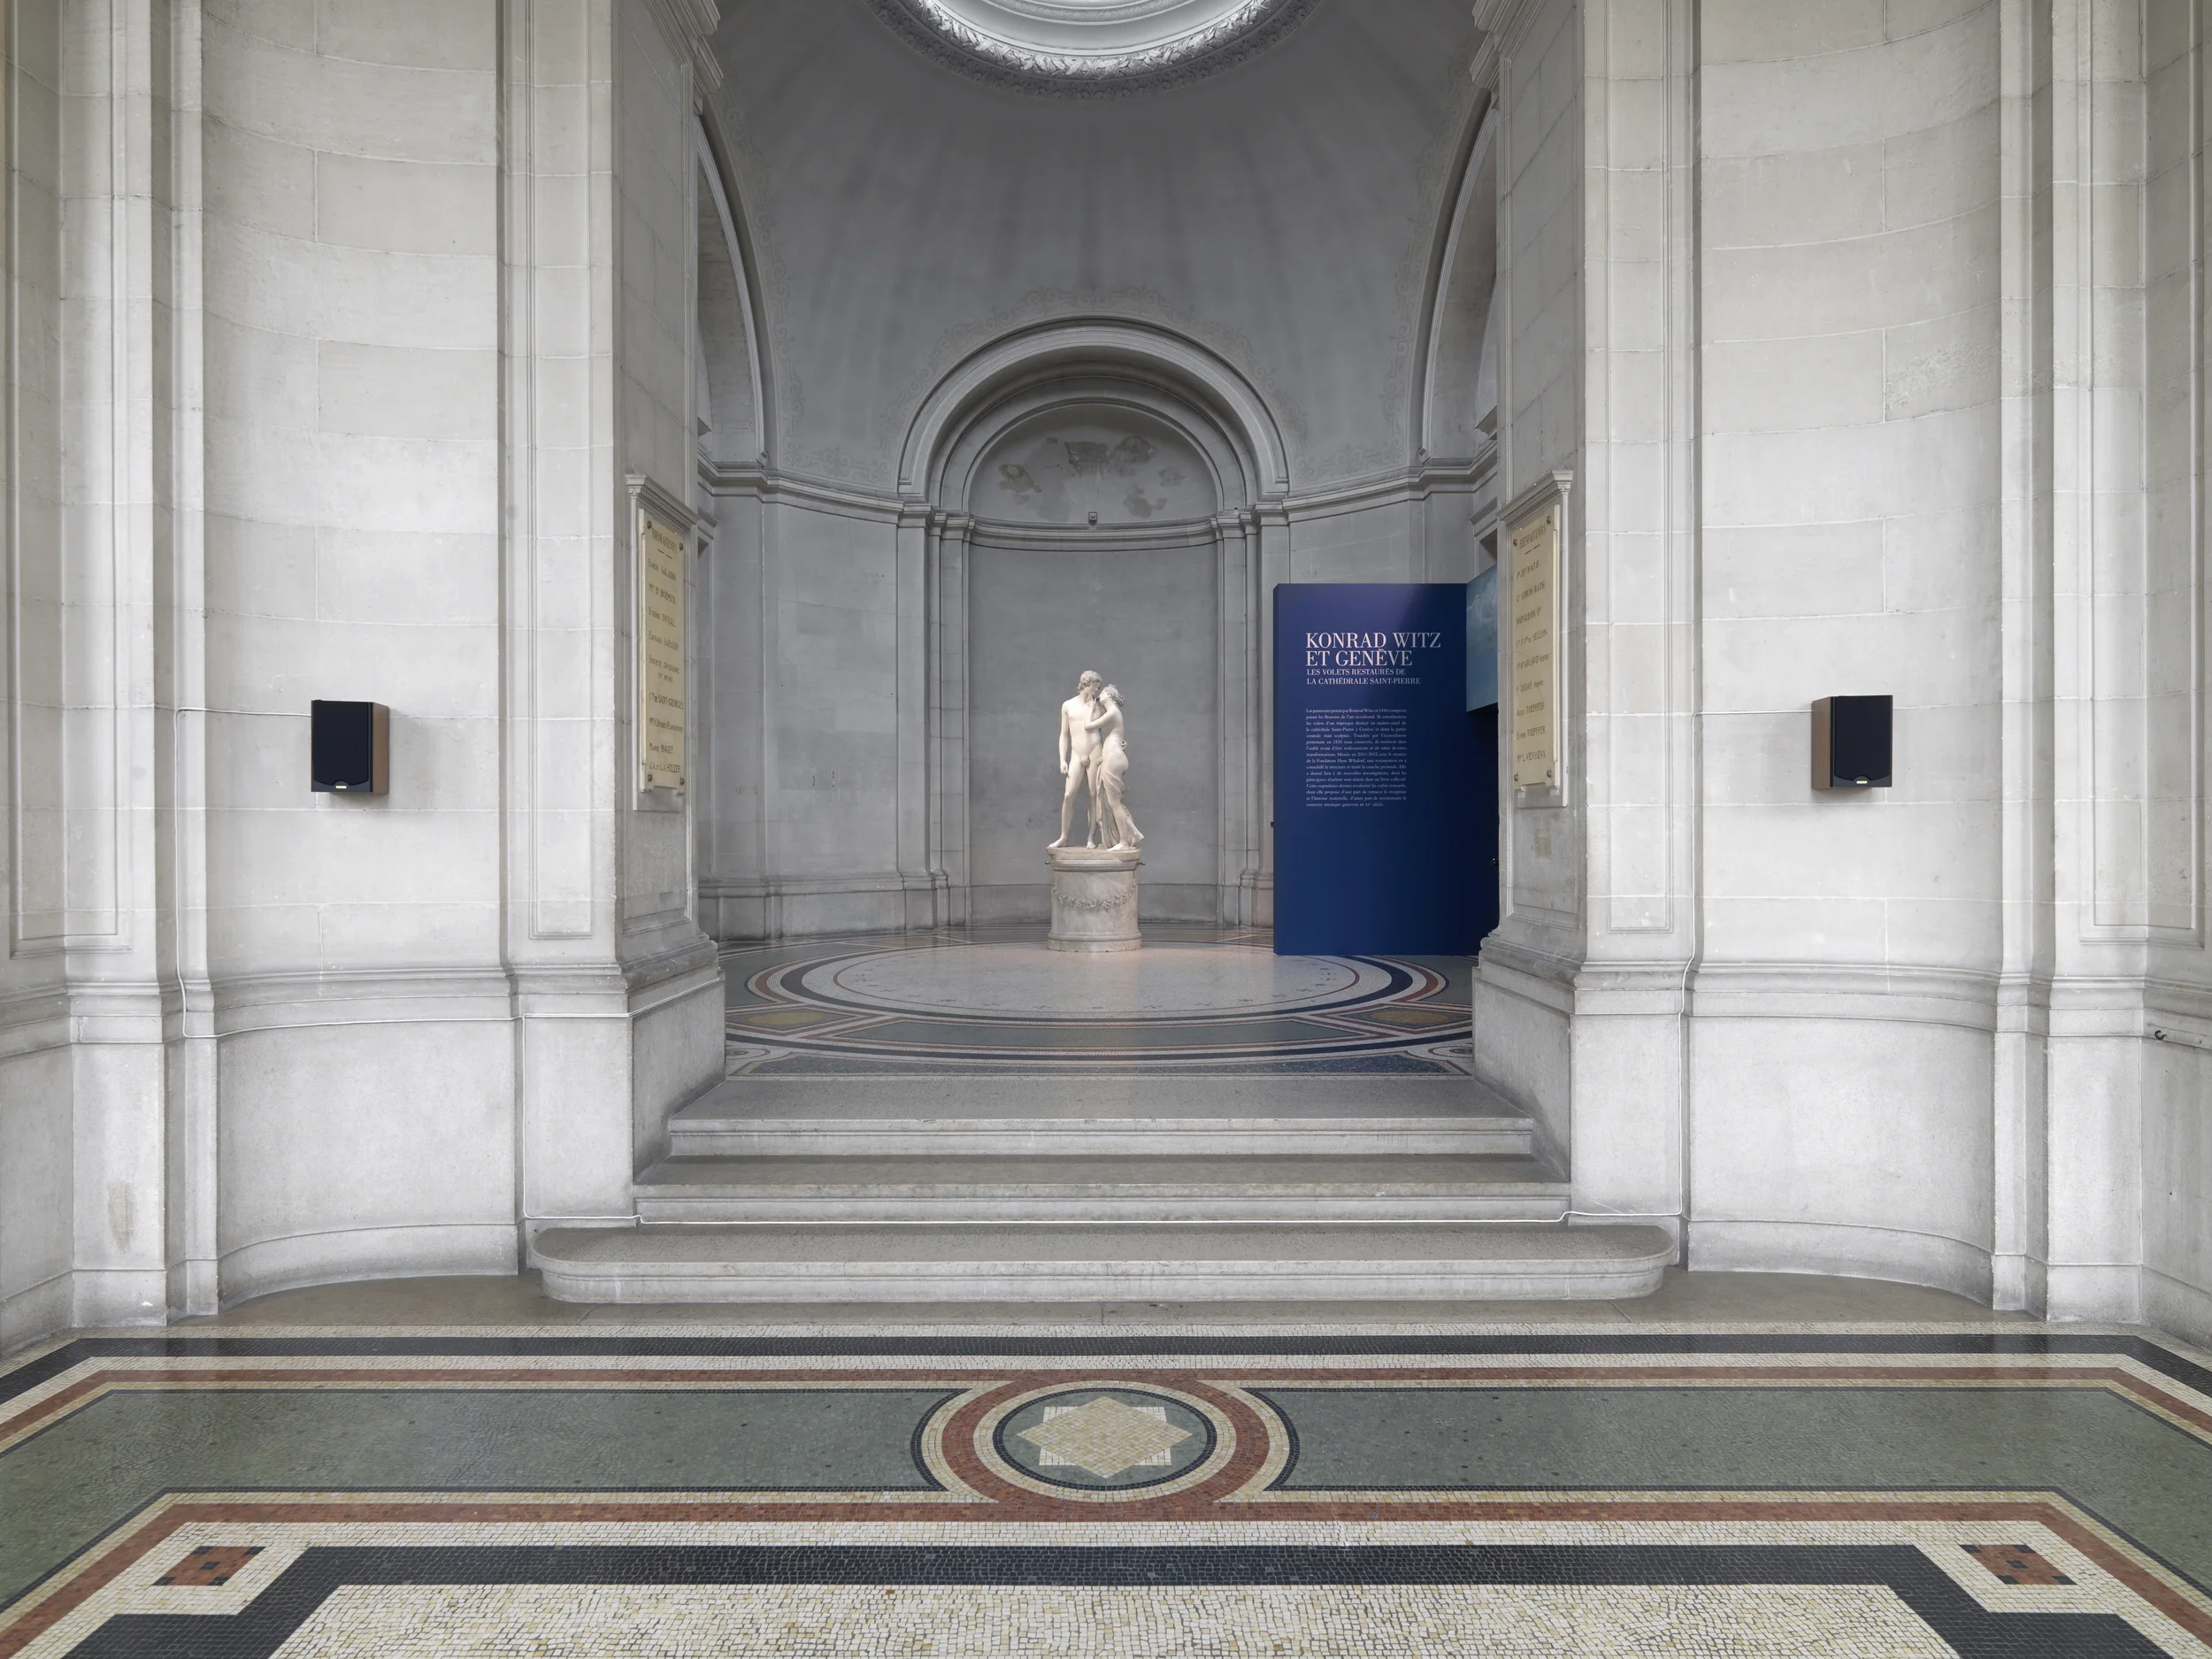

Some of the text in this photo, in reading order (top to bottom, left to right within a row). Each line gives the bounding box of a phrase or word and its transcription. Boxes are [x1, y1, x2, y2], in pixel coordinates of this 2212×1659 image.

[1305, 632, 1441, 649] KONRAD WITZ
[1305, 648, 1413, 666] ET GENÈVE
